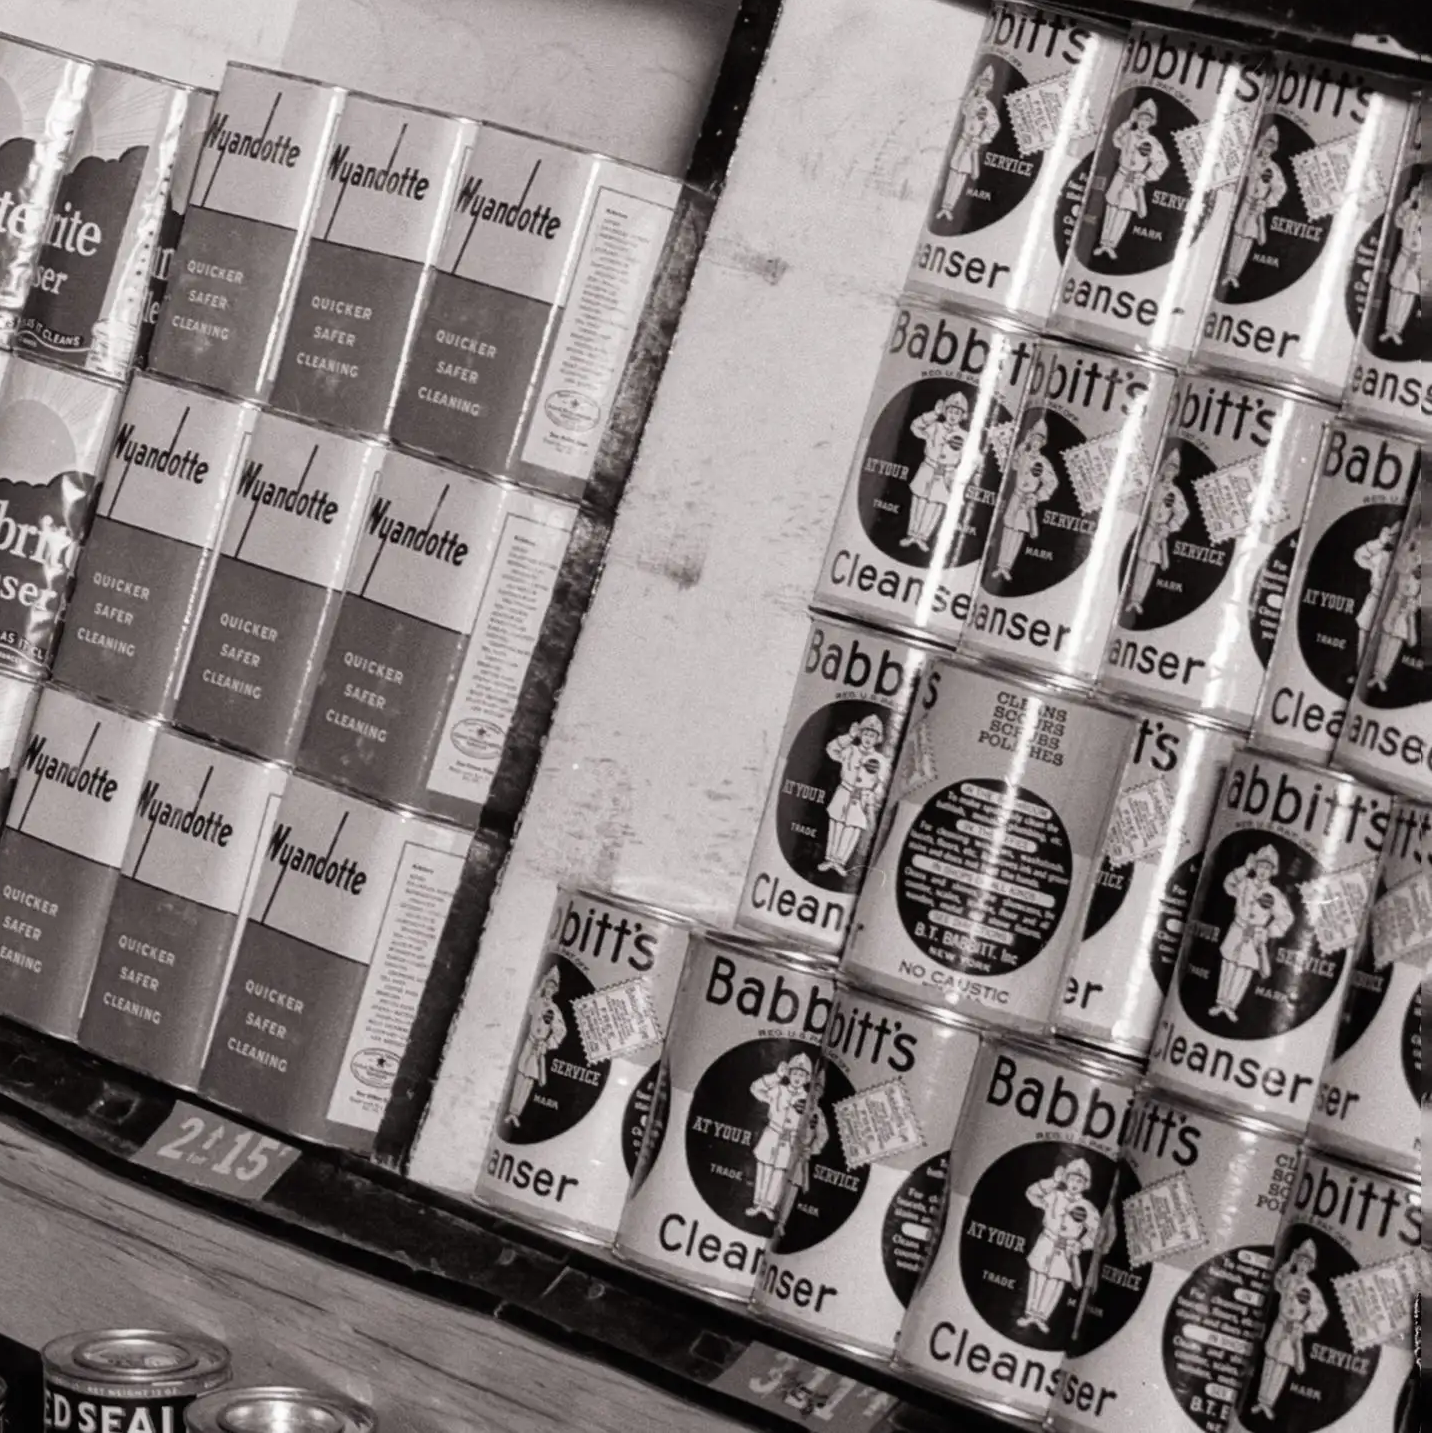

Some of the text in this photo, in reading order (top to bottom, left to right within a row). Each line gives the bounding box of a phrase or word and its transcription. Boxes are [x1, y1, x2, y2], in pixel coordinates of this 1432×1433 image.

[329, 146, 430, 201] Wyandotte
[984, 151, 1032, 176] SERVICE
[457, 179, 561, 240] Wyandotte
[434, 328, 498, 356] QUICKER
[436, 362, 479, 383] SAFER
[418, 385, 480, 414] CLEANING
[1276, 949, 1335, 978] SERVICE
[900, 961, 1009, 1004] NO CAUSTIC
[969, 1221, 1026, 1252] AT YOUR
